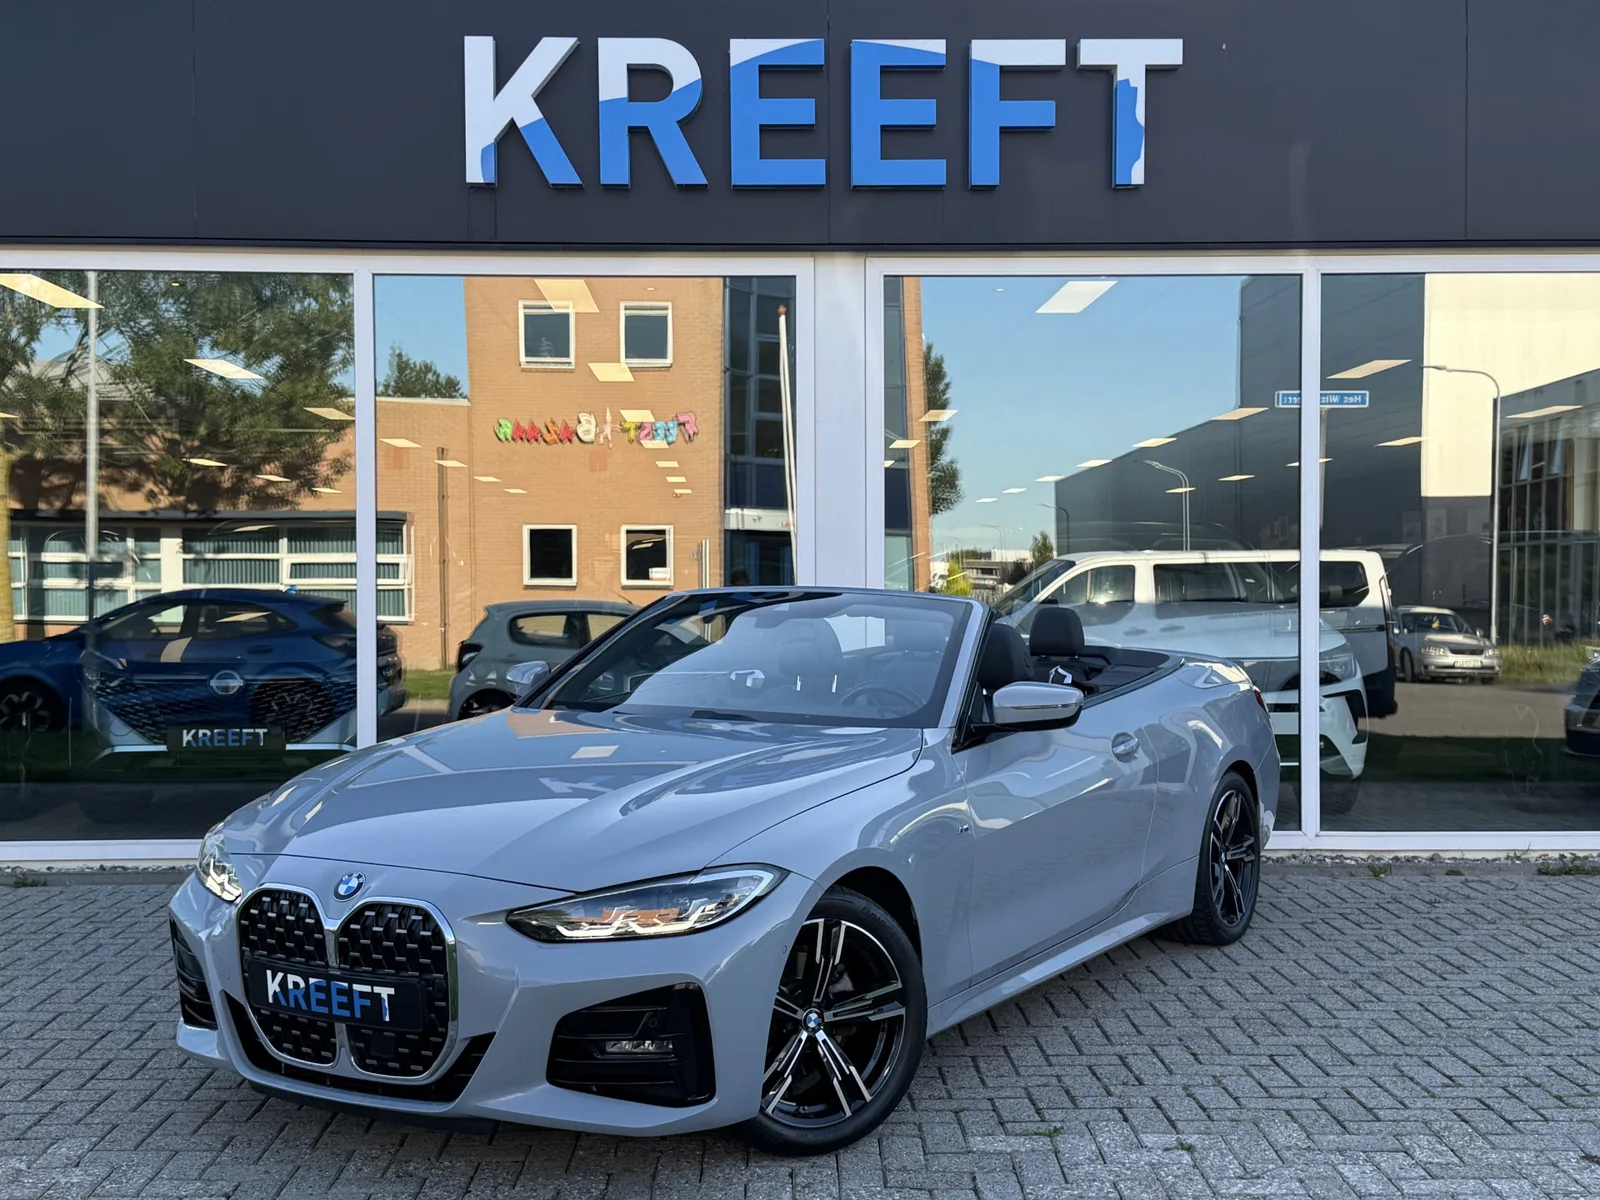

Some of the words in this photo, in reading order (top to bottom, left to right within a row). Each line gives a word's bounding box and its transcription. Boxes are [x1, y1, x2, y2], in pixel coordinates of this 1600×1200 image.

[464, 36, 1184, 188] KREEFT
[182, 728, 268, 747] KREEFT
[266, 969, 395, 1022] KREEFT
